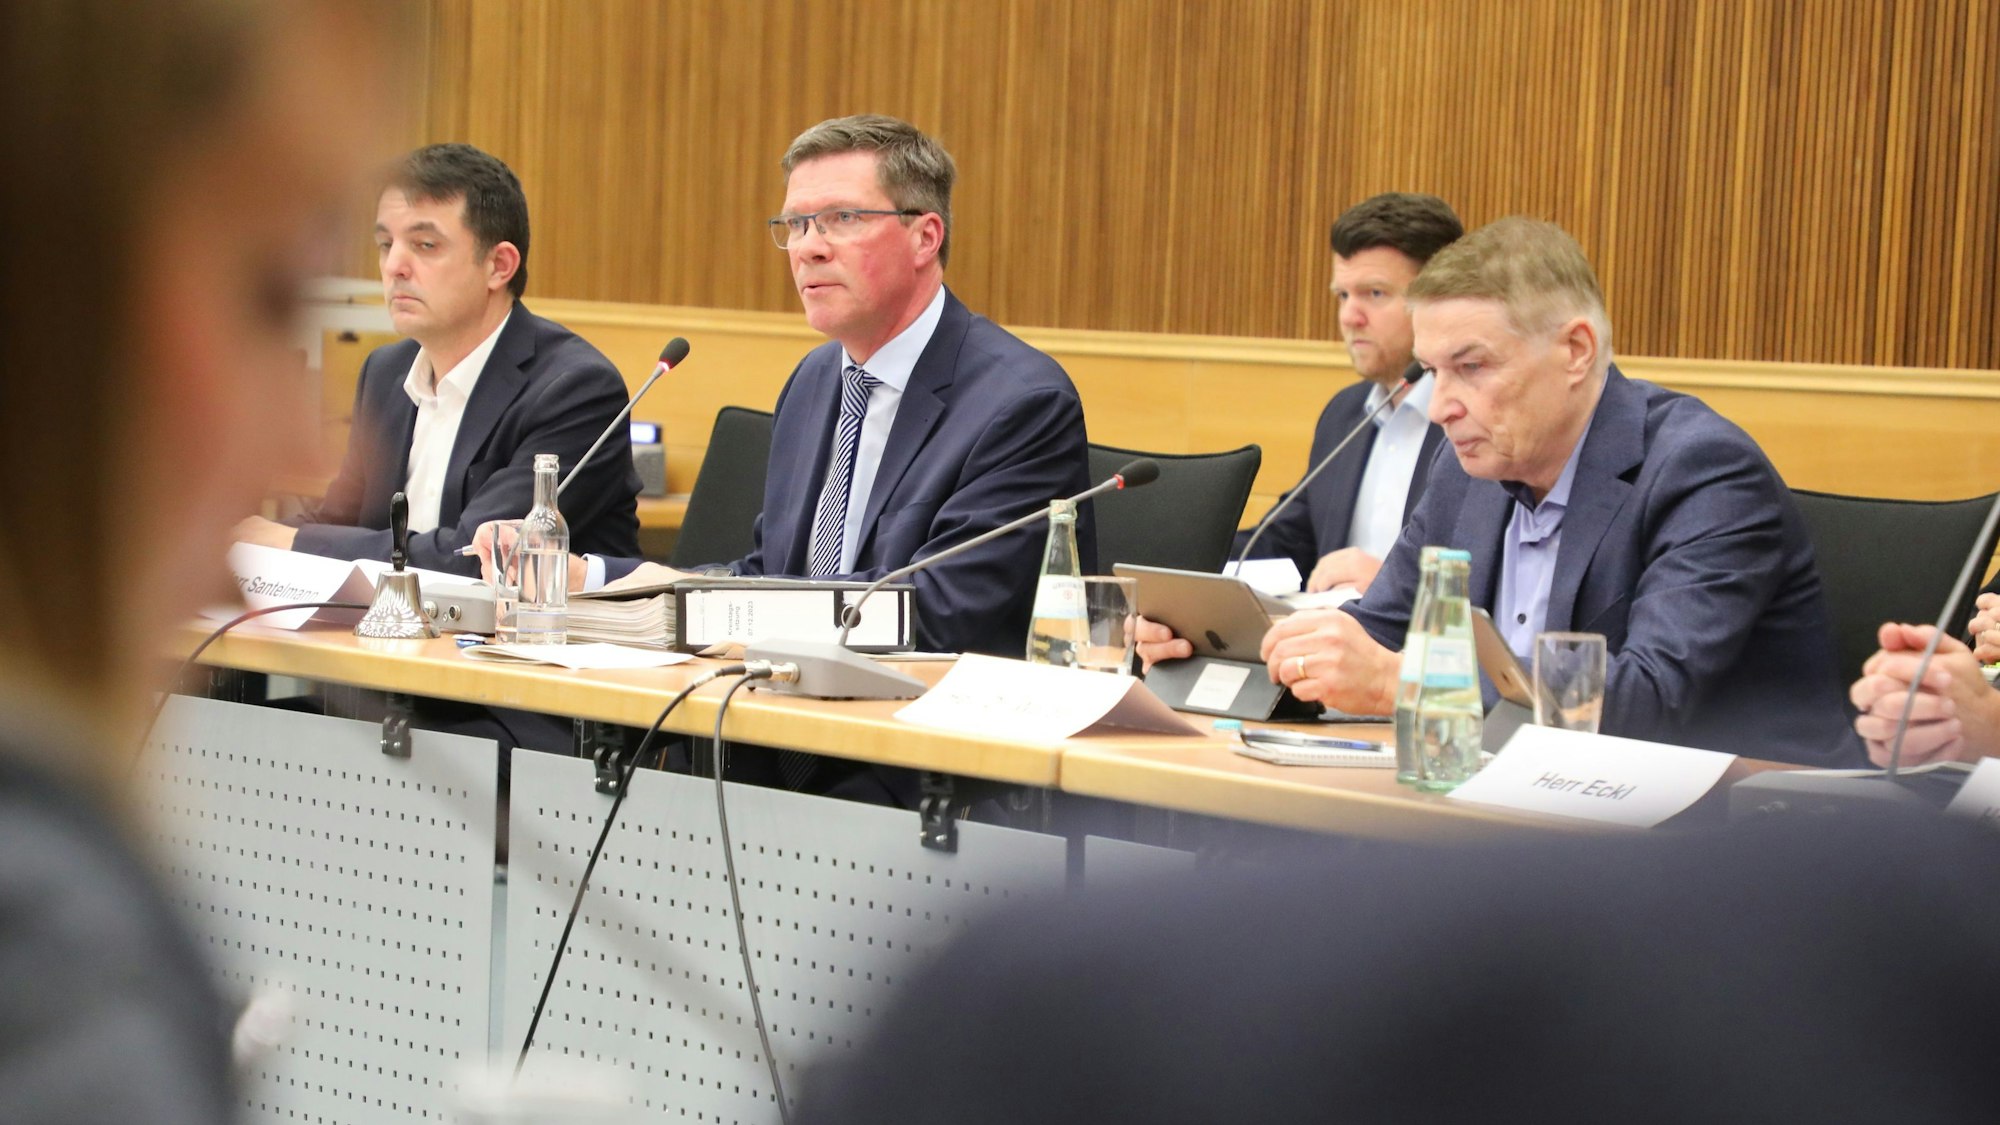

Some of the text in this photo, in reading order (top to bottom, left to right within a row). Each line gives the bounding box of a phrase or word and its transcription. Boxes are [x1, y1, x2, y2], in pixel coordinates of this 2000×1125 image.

[247, 576, 319, 602] Santelmann
[1532, 771, 1637, 800] Herr Eckl
